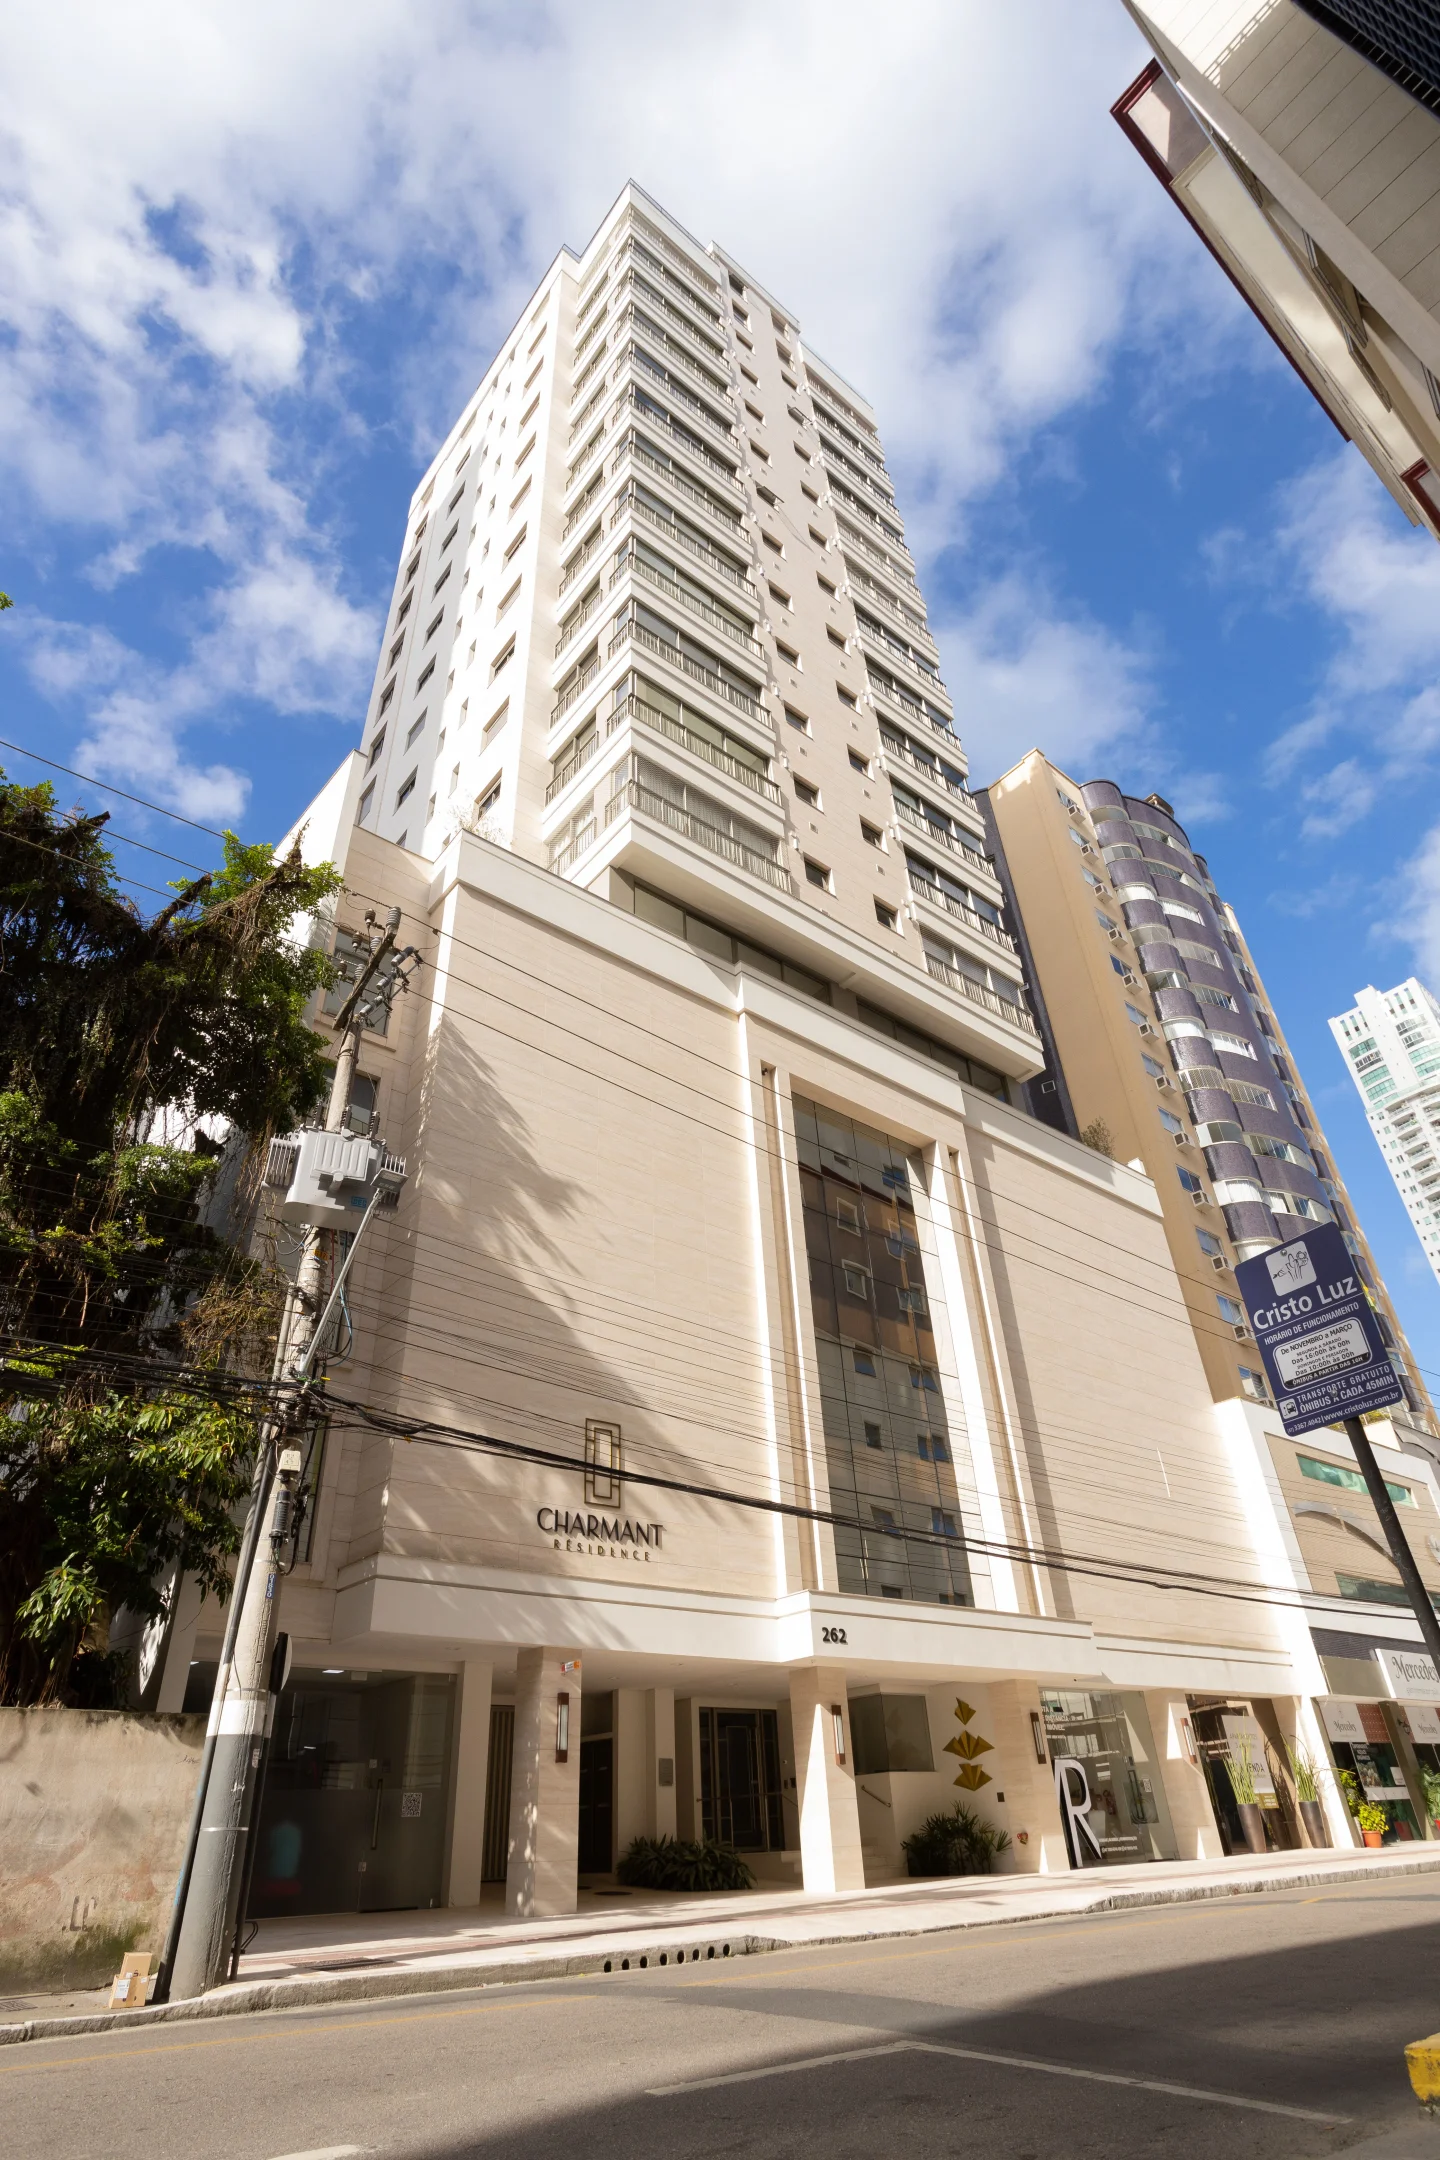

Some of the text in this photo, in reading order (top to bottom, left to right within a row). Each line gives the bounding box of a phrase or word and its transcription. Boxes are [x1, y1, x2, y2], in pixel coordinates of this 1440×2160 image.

[1253, 1277, 1357, 1330] Cristo Luz
[1264, 1301, 1359, 1346] HORÁRIO DE FUNCIONAMENTO
[1290, 1335, 1324, 1352] NOVEMBRO
[1329, 1323, 1352, 1337] MARÇO
[1292, 1356, 1304, 1365] Das
[1296, 1369, 1308, 1377] Das
[1318, 1364, 1340, 1375] PARTIR
[1340, 1359, 1352, 1368] DAS
[1297, 1365, 1390, 1402] TRANSPORTE GRATUITO
[1299, 1394, 1332, 1413] ÔNIBUS
[1340, 1386, 1364, 1400] CADA
[1366, 1374, 1394, 1391] 45MIN
[536, 1507, 663, 1547] CHARMANT
[822, 1626, 847, 1644] 262
[1055, 1759, 1102, 1868] R
